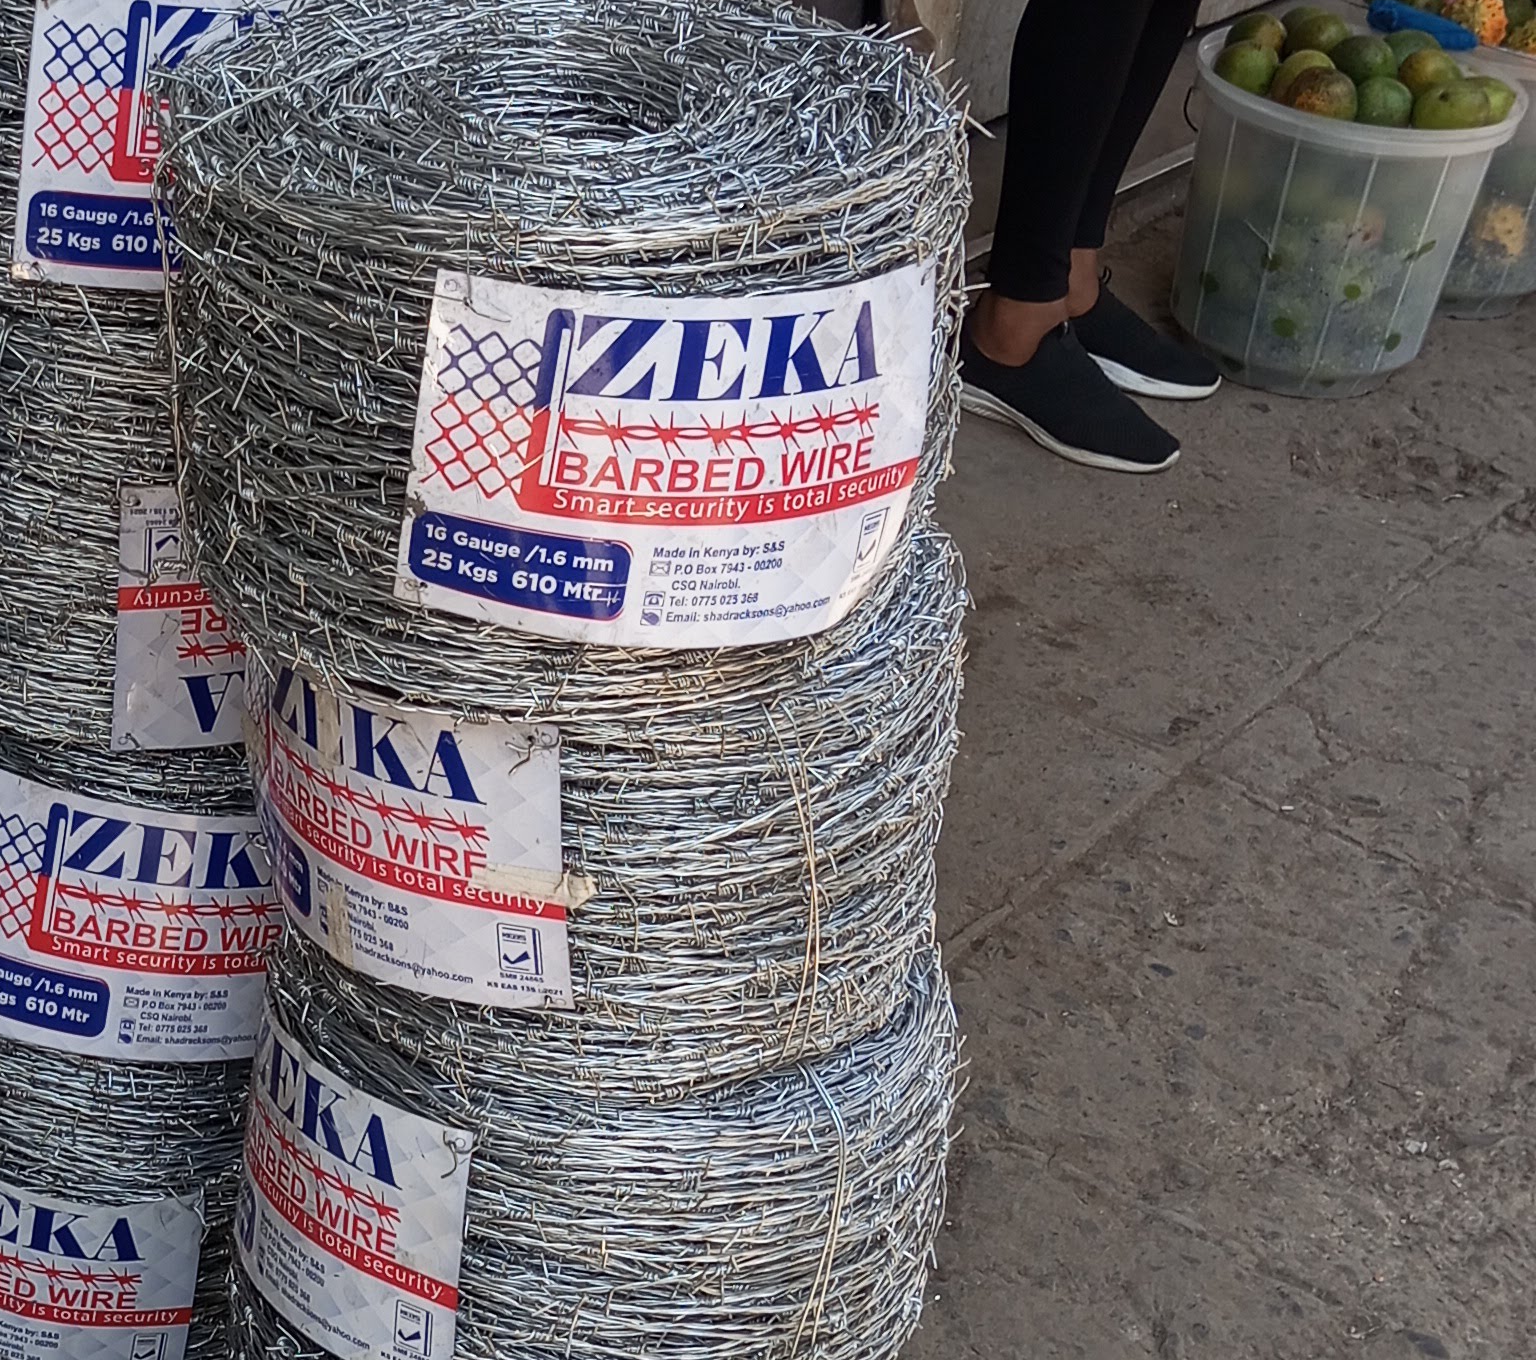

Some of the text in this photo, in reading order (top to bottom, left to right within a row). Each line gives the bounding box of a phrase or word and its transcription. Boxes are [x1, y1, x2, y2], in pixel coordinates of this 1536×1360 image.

[37, 227, 147, 253] 25 Kgs 610
[40, 203, 118, 225] 16 Gauge
[566, 300, 882, 402] ZEKA
[554, 434, 875, 493] BARBED WIRE
[553, 464, 908, 523] Smart security is total security
[421, 547, 603, 601] 25 Kgs 610 Mtr
[425, 524, 614, 572] 16 Gauge /1.6 mm
[276, 762, 371, 848] BARBED
[63, 810, 273, 889] ZEK
[307, 827, 546, 915] security is total security
[52, 908, 283, 952] BARBED WIR
[52, 936, 109, 962] Smart
[114, 948, 197, 973] security
[202, 954, 217, 969] is
[26, 994, 58, 1016] 610
[62, 1005, 90, 1023] Mtr
[34, 976, 64, 994] /1.6
[68, 986, 98, 1002] mm
[270, 1040, 402, 1190] EKA
[316, 1191, 397, 1259] WIRE
[320, 1228, 442, 1300] total security
[31, 1300, 46, 1315] is
[52, 1306, 96, 1323] total
[103, 1307, 177, 1325] security
[48, 1280, 138, 1310] WIRE
